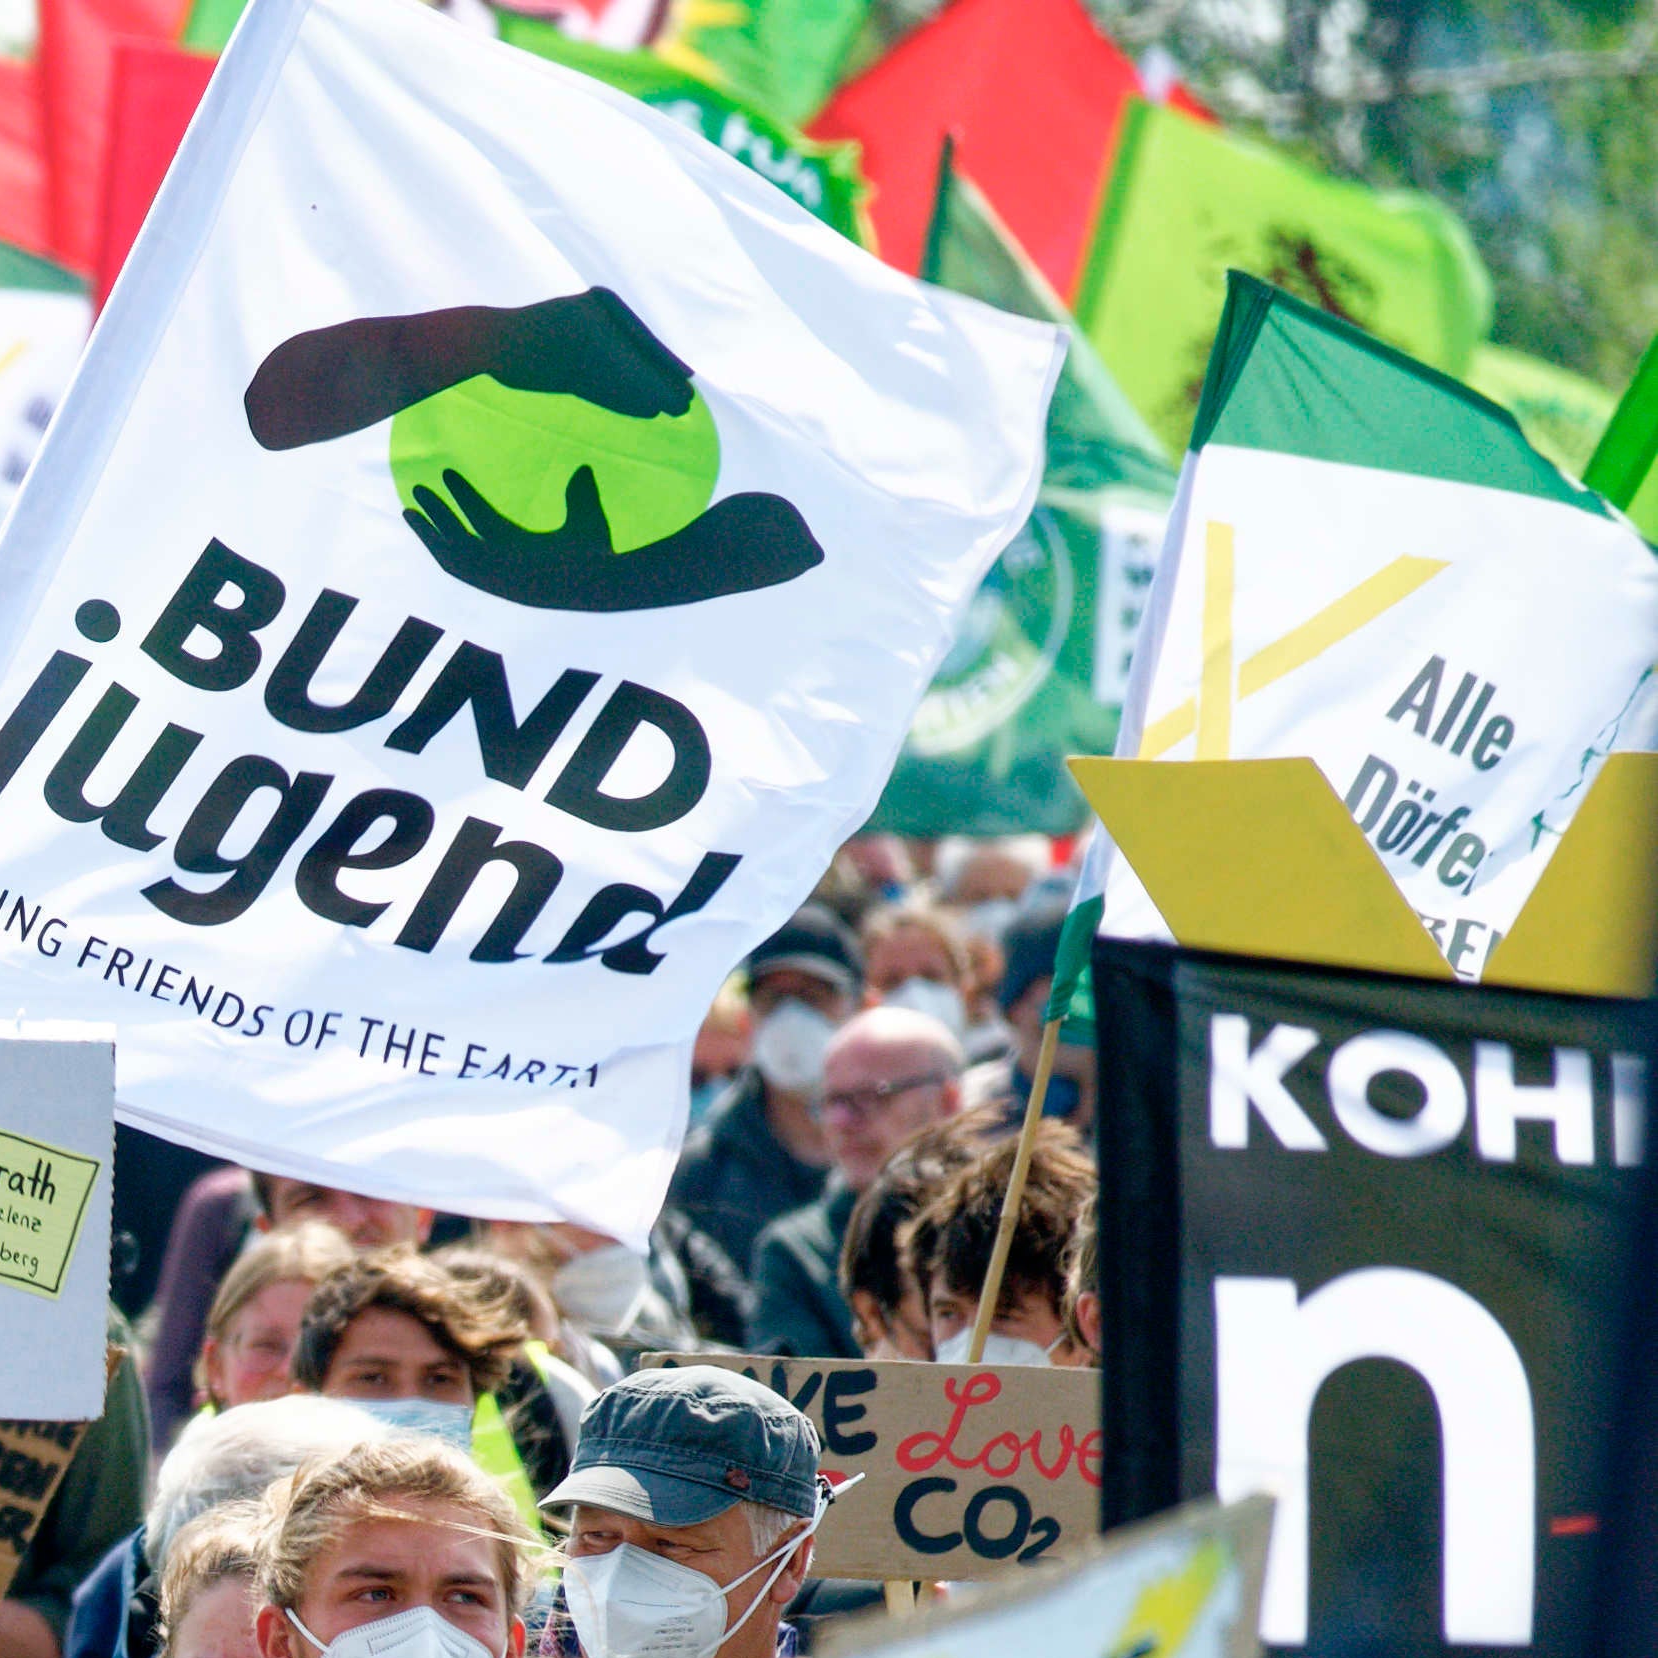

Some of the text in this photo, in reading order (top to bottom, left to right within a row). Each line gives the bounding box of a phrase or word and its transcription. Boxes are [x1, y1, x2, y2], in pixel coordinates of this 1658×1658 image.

[140, 537, 712, 831] BUND
[1385, 653, 1515, 772] Alle
[77, 937, 275, 1037] FRIENDS
[284, 1010, 342, 1050] OF
[359, 1017, 443, 1077] THE
[896, 1372, 1102, 1487] Love
